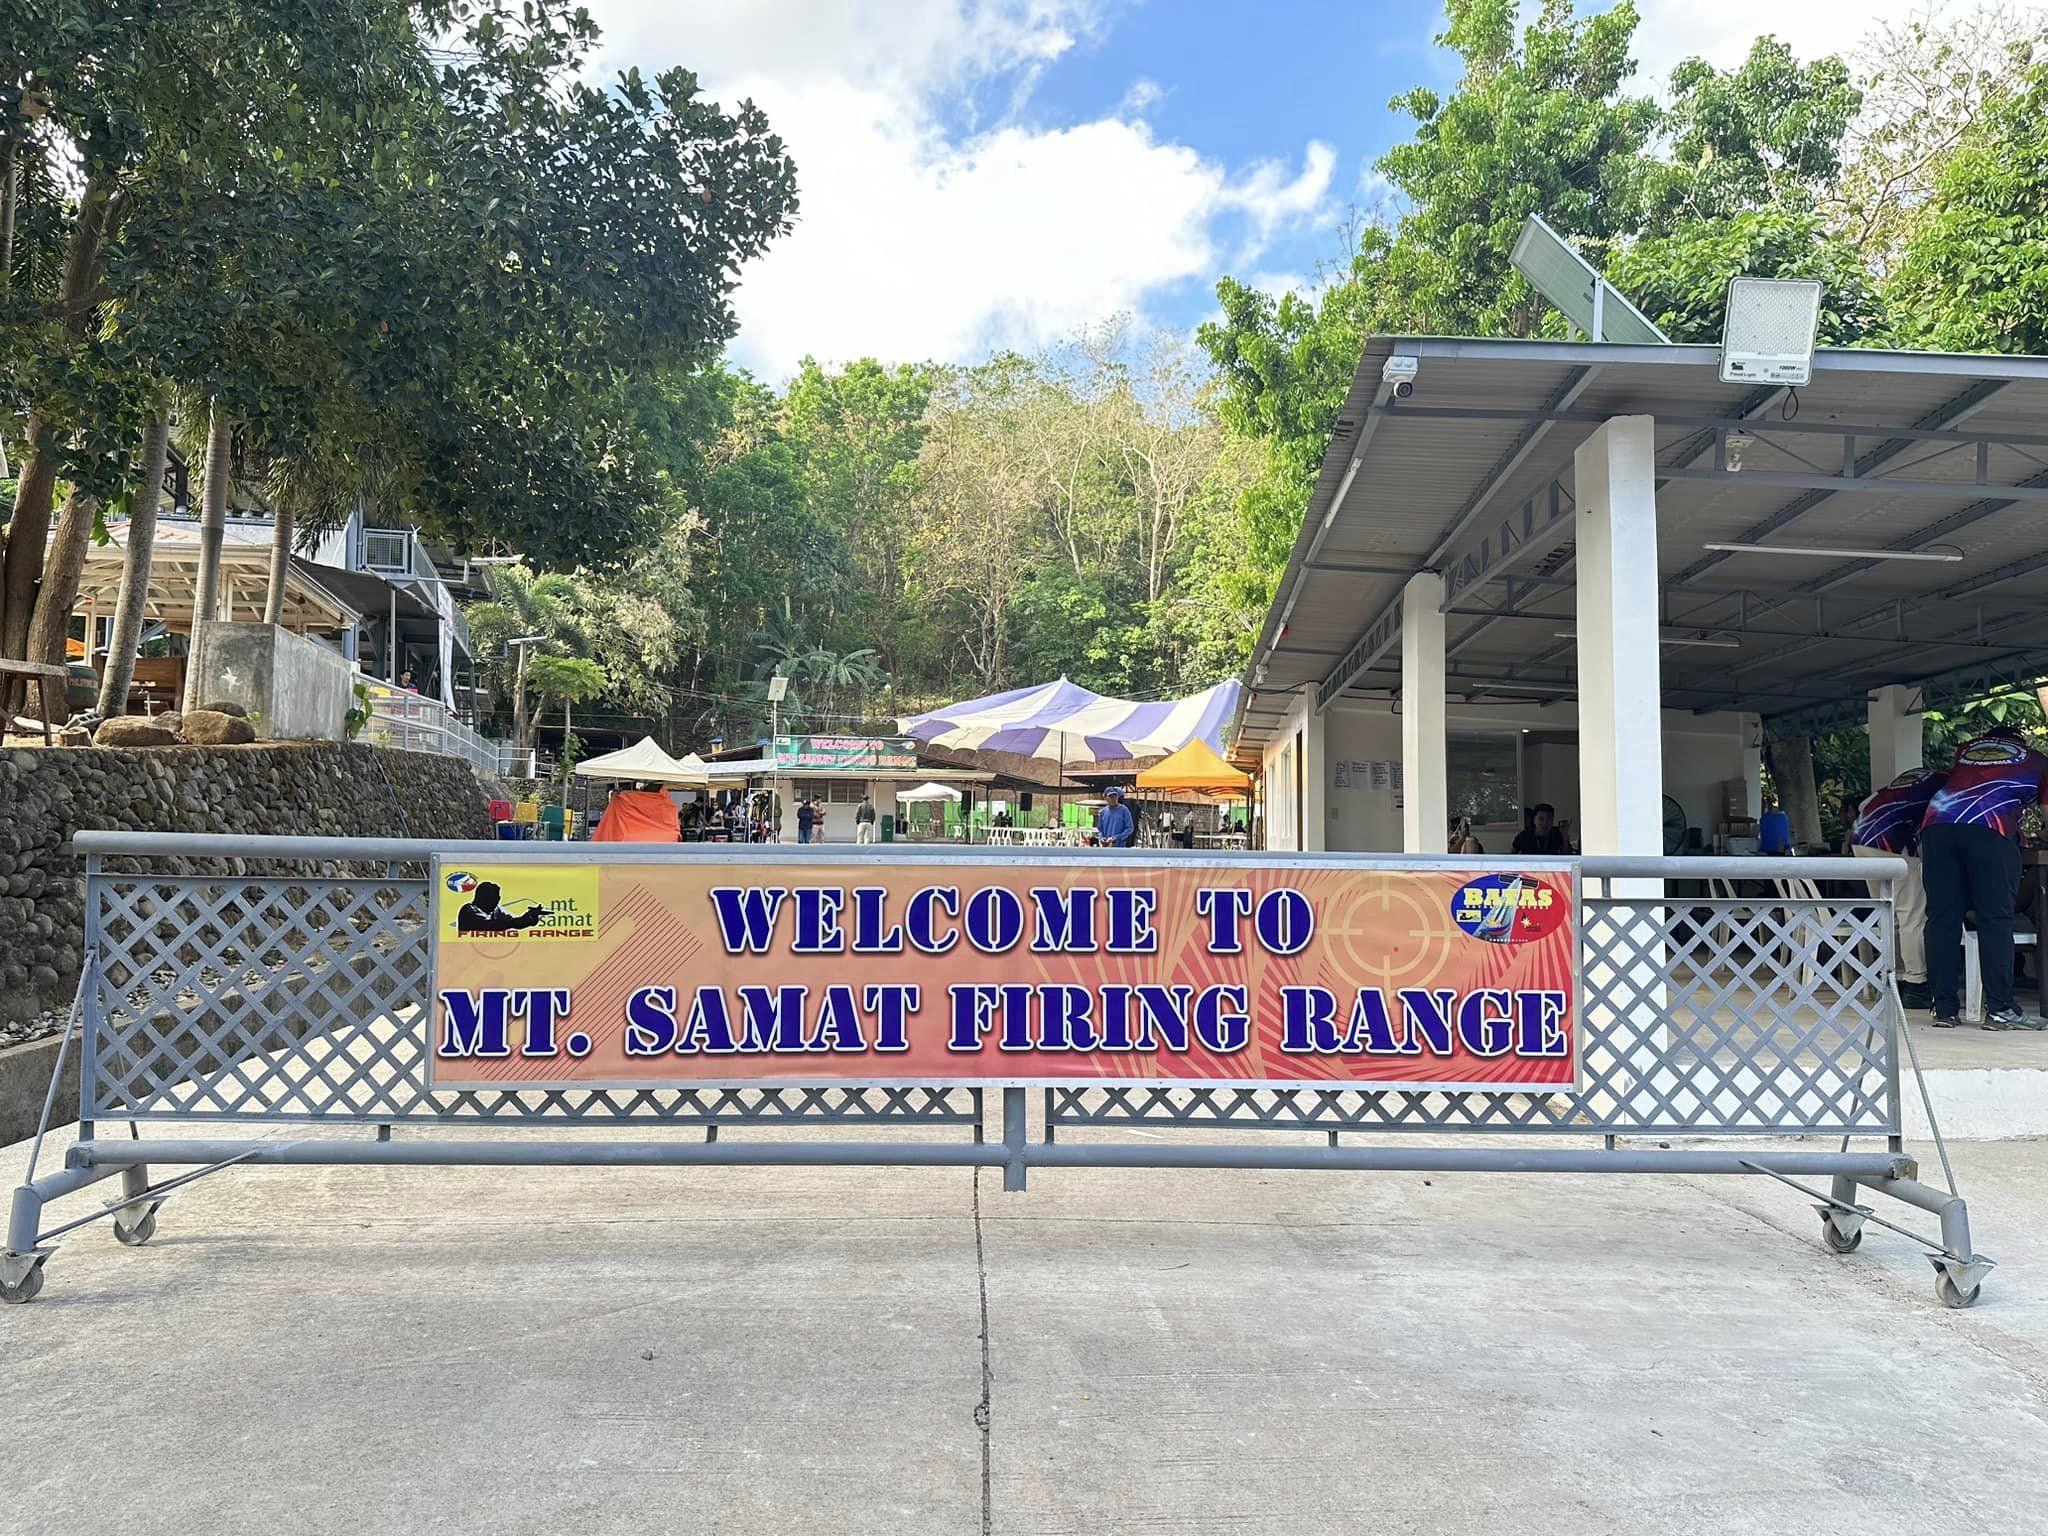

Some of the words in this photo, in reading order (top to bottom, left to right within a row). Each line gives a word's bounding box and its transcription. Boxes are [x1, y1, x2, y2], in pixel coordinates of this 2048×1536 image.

[551, 897, 578, 912] mt.
[1464, 887, 1553, 906] BATAS
[538, 912, 592, 927] samat
[710, 886, 1157, 953] WELCOME
[1197, 888, 1314, 955] TO
[458, 929, 519, 938] FIRING
[529, 929, 594, 937] RANGE
[438, 988, 592, 1057] MT.
[625, 985, 920, 1054] SAMAT
[948, 984, 1250, 1053] FIRING
[1280, 986, 1567, 1057] RANGE
